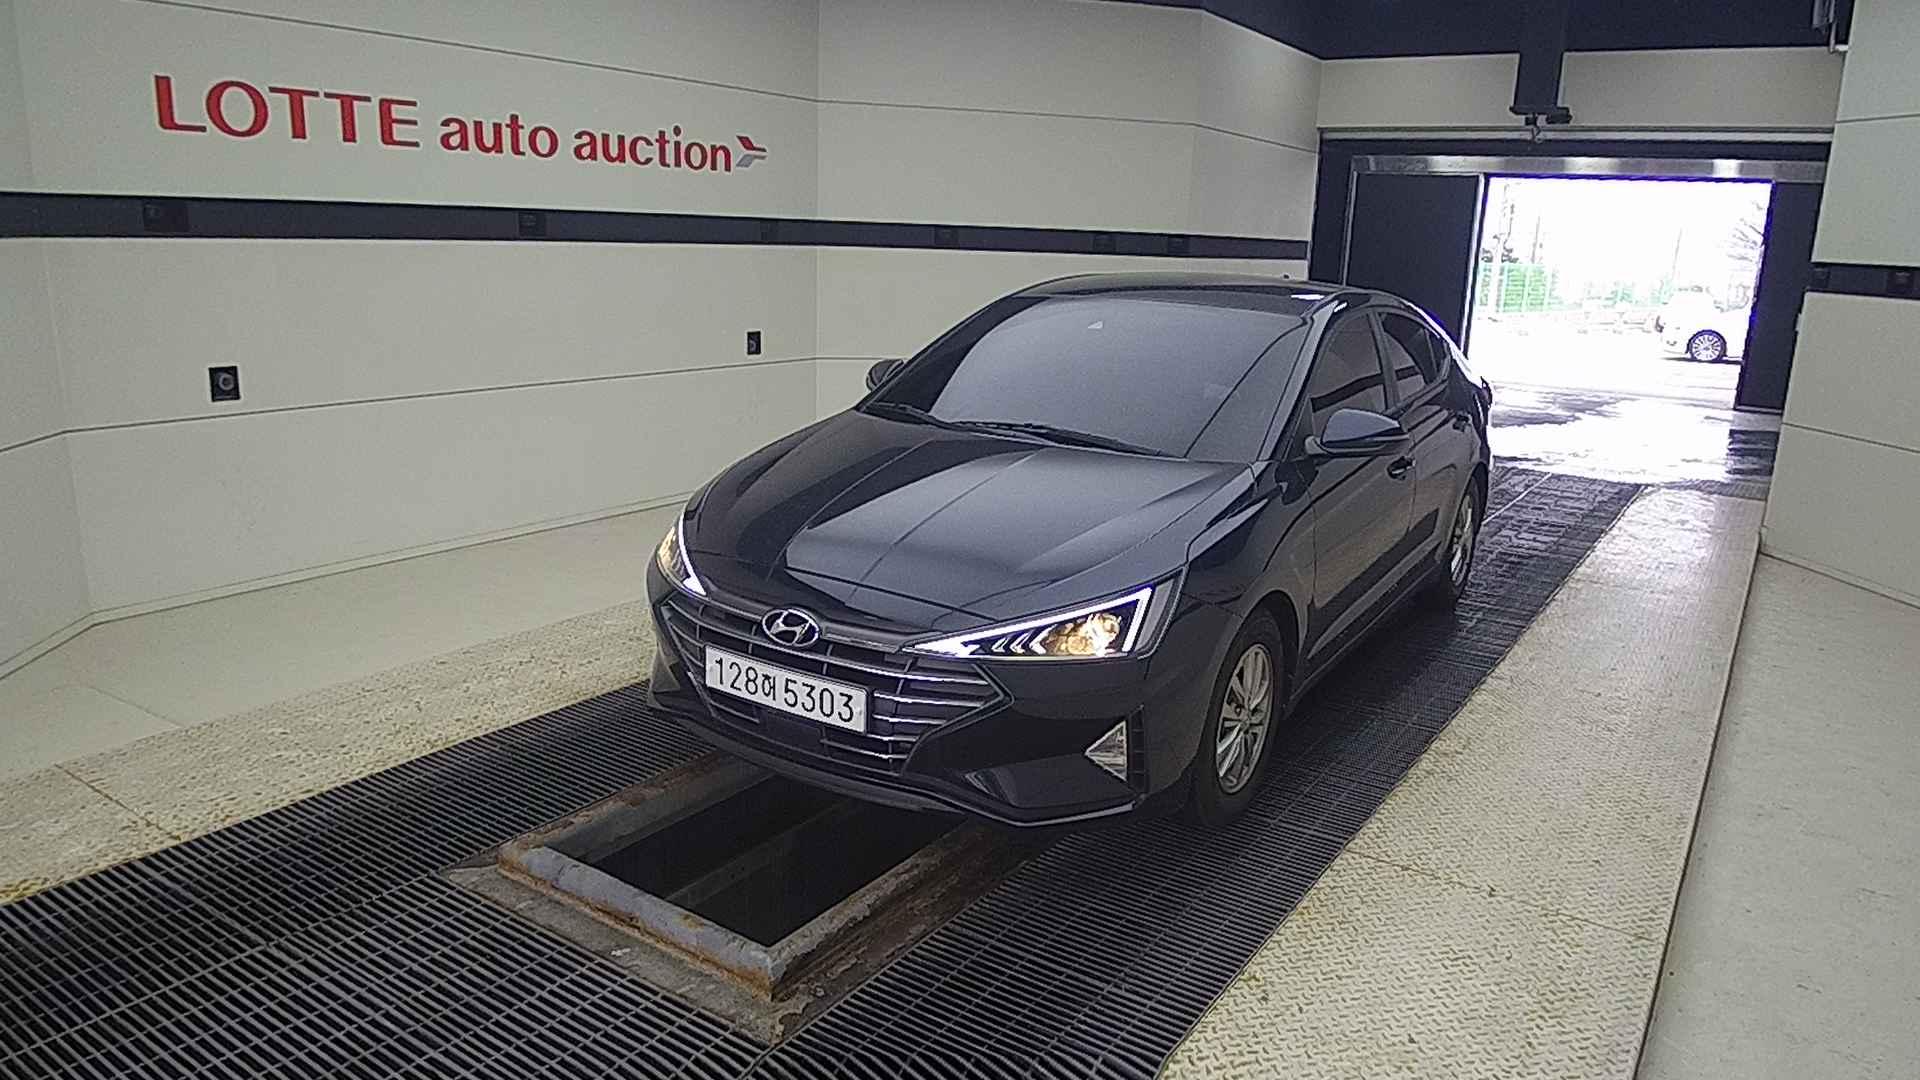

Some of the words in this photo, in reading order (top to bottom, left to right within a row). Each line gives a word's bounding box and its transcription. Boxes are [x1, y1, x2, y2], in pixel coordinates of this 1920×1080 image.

[155, 75, 418, 148] LOTTE
[440, 115, 560, 158] auto
[574, 126, 732, 172] auction
